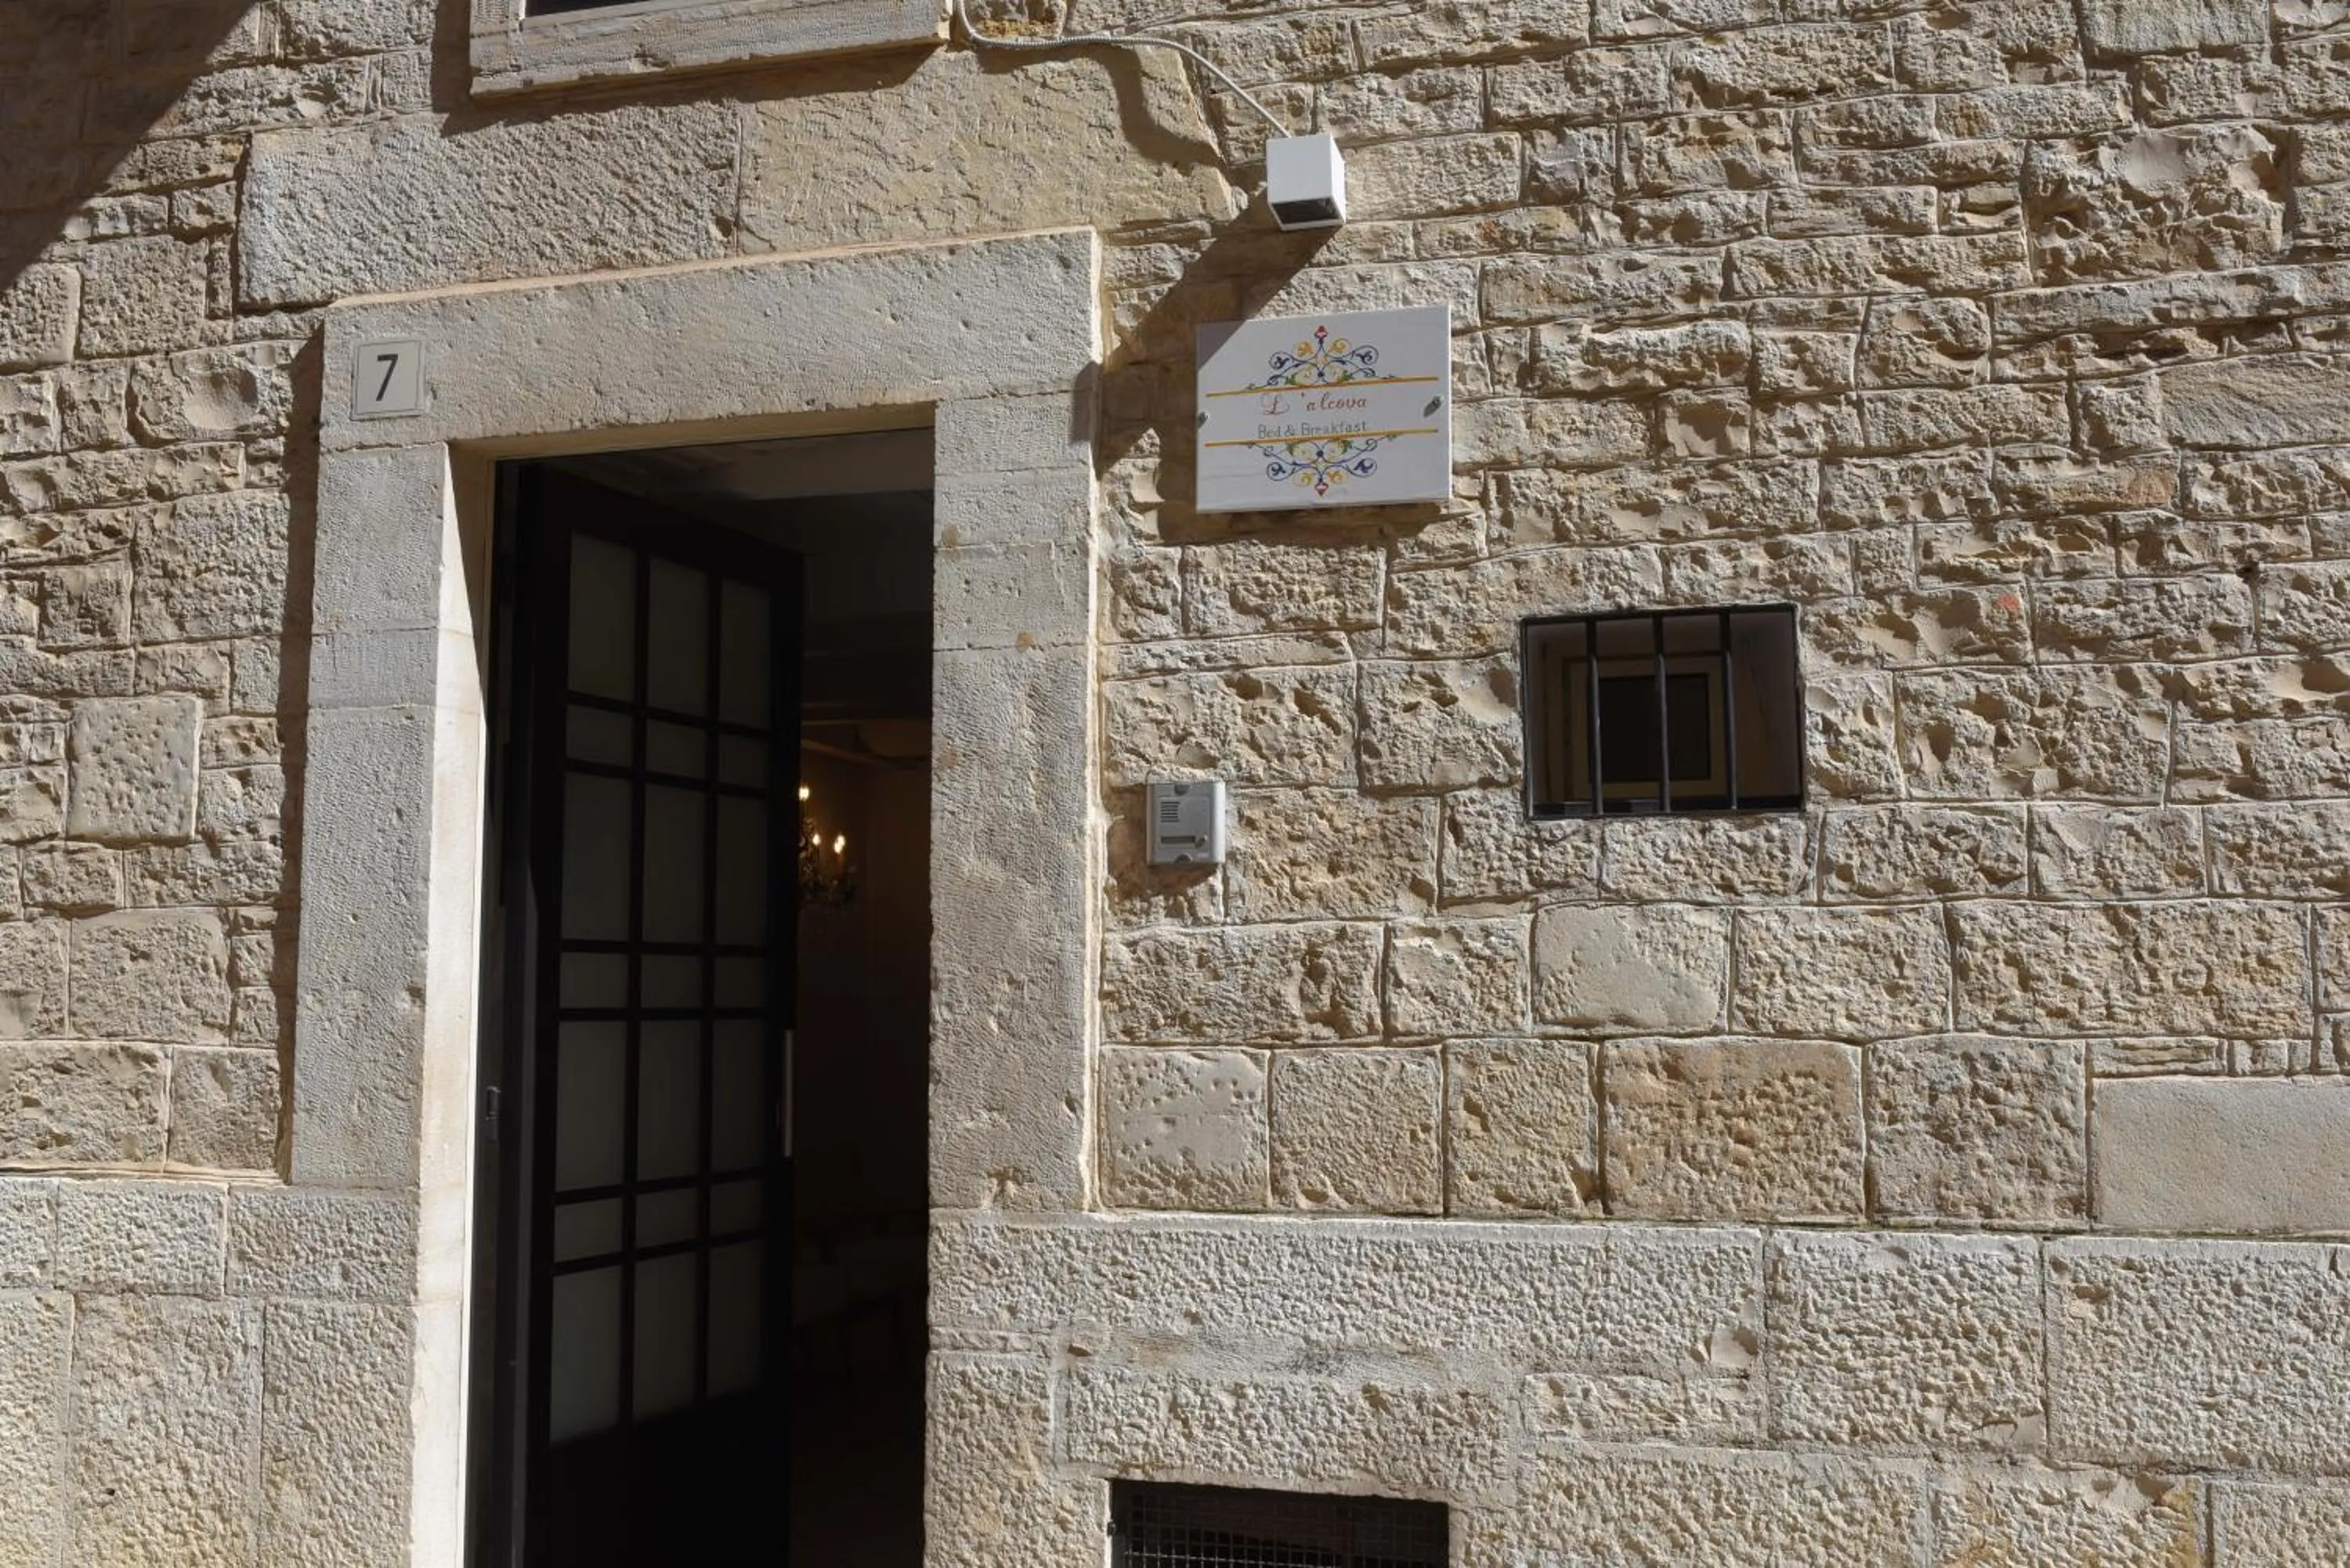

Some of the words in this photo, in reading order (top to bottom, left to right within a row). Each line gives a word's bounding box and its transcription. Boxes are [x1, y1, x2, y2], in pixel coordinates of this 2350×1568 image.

[376, 354, 399, 402] 7
[1258, 424, 1281, 439] Bed
[1285, 424, 1295, 435] &
[1300, 421, 1366, 435] Breakfast
